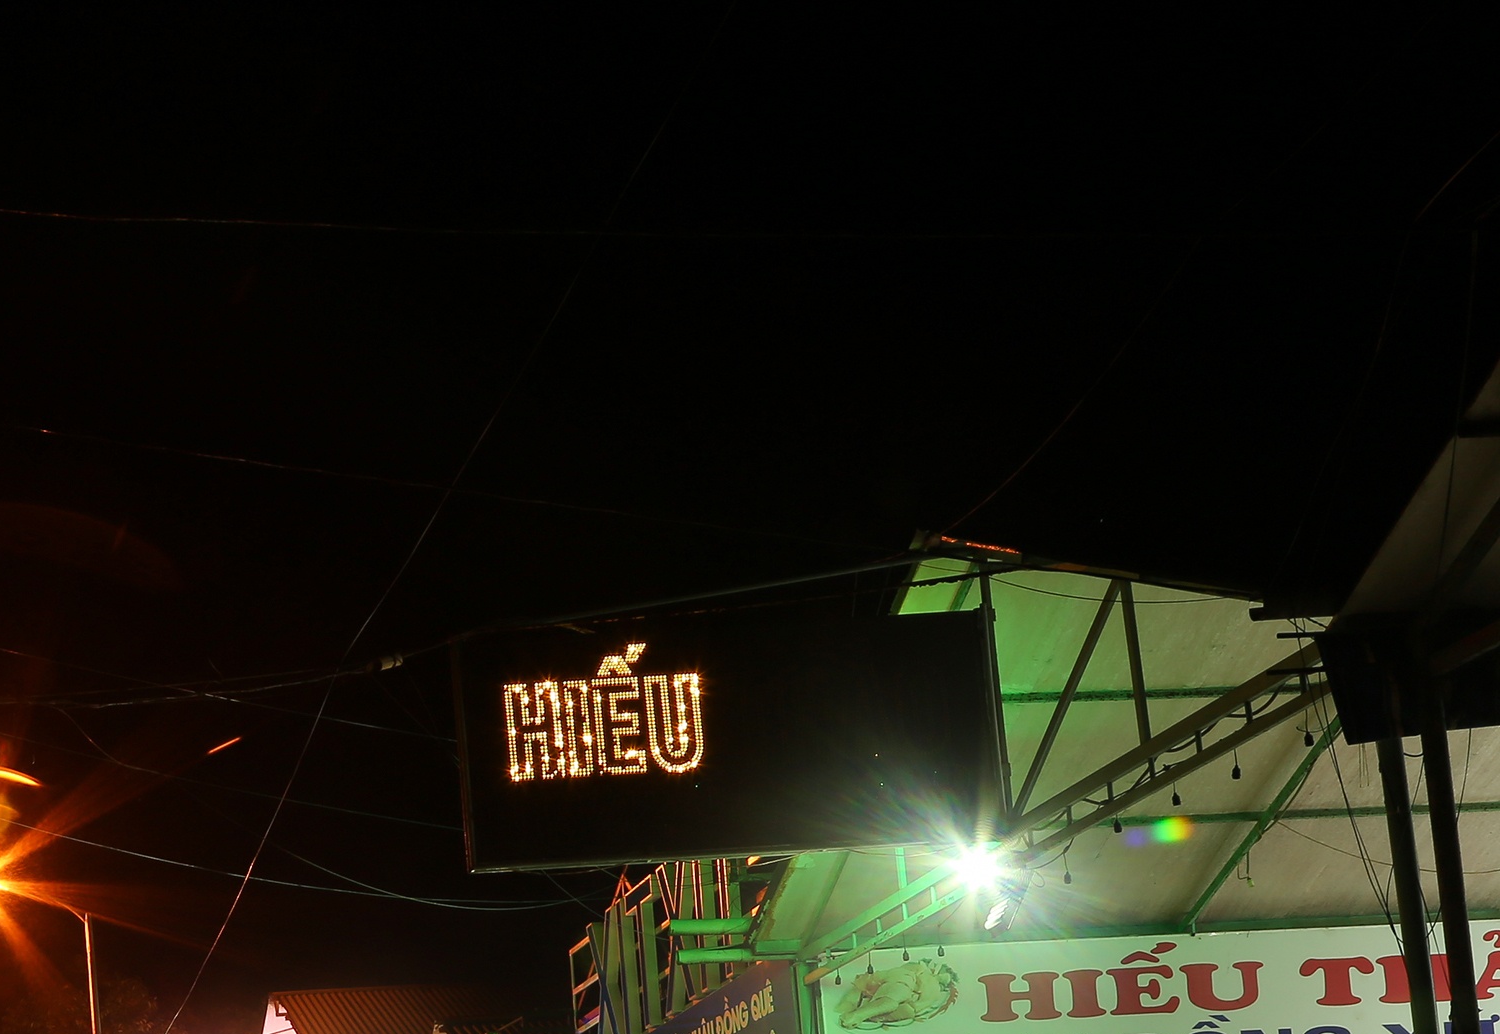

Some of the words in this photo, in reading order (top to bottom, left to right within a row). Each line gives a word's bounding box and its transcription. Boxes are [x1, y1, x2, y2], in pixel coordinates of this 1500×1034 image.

[503, 642, 705, 782] HIẾU
[750, 978, 775, 1022] QUÊ
[978, 942, 1264, 1022] HIẾU
